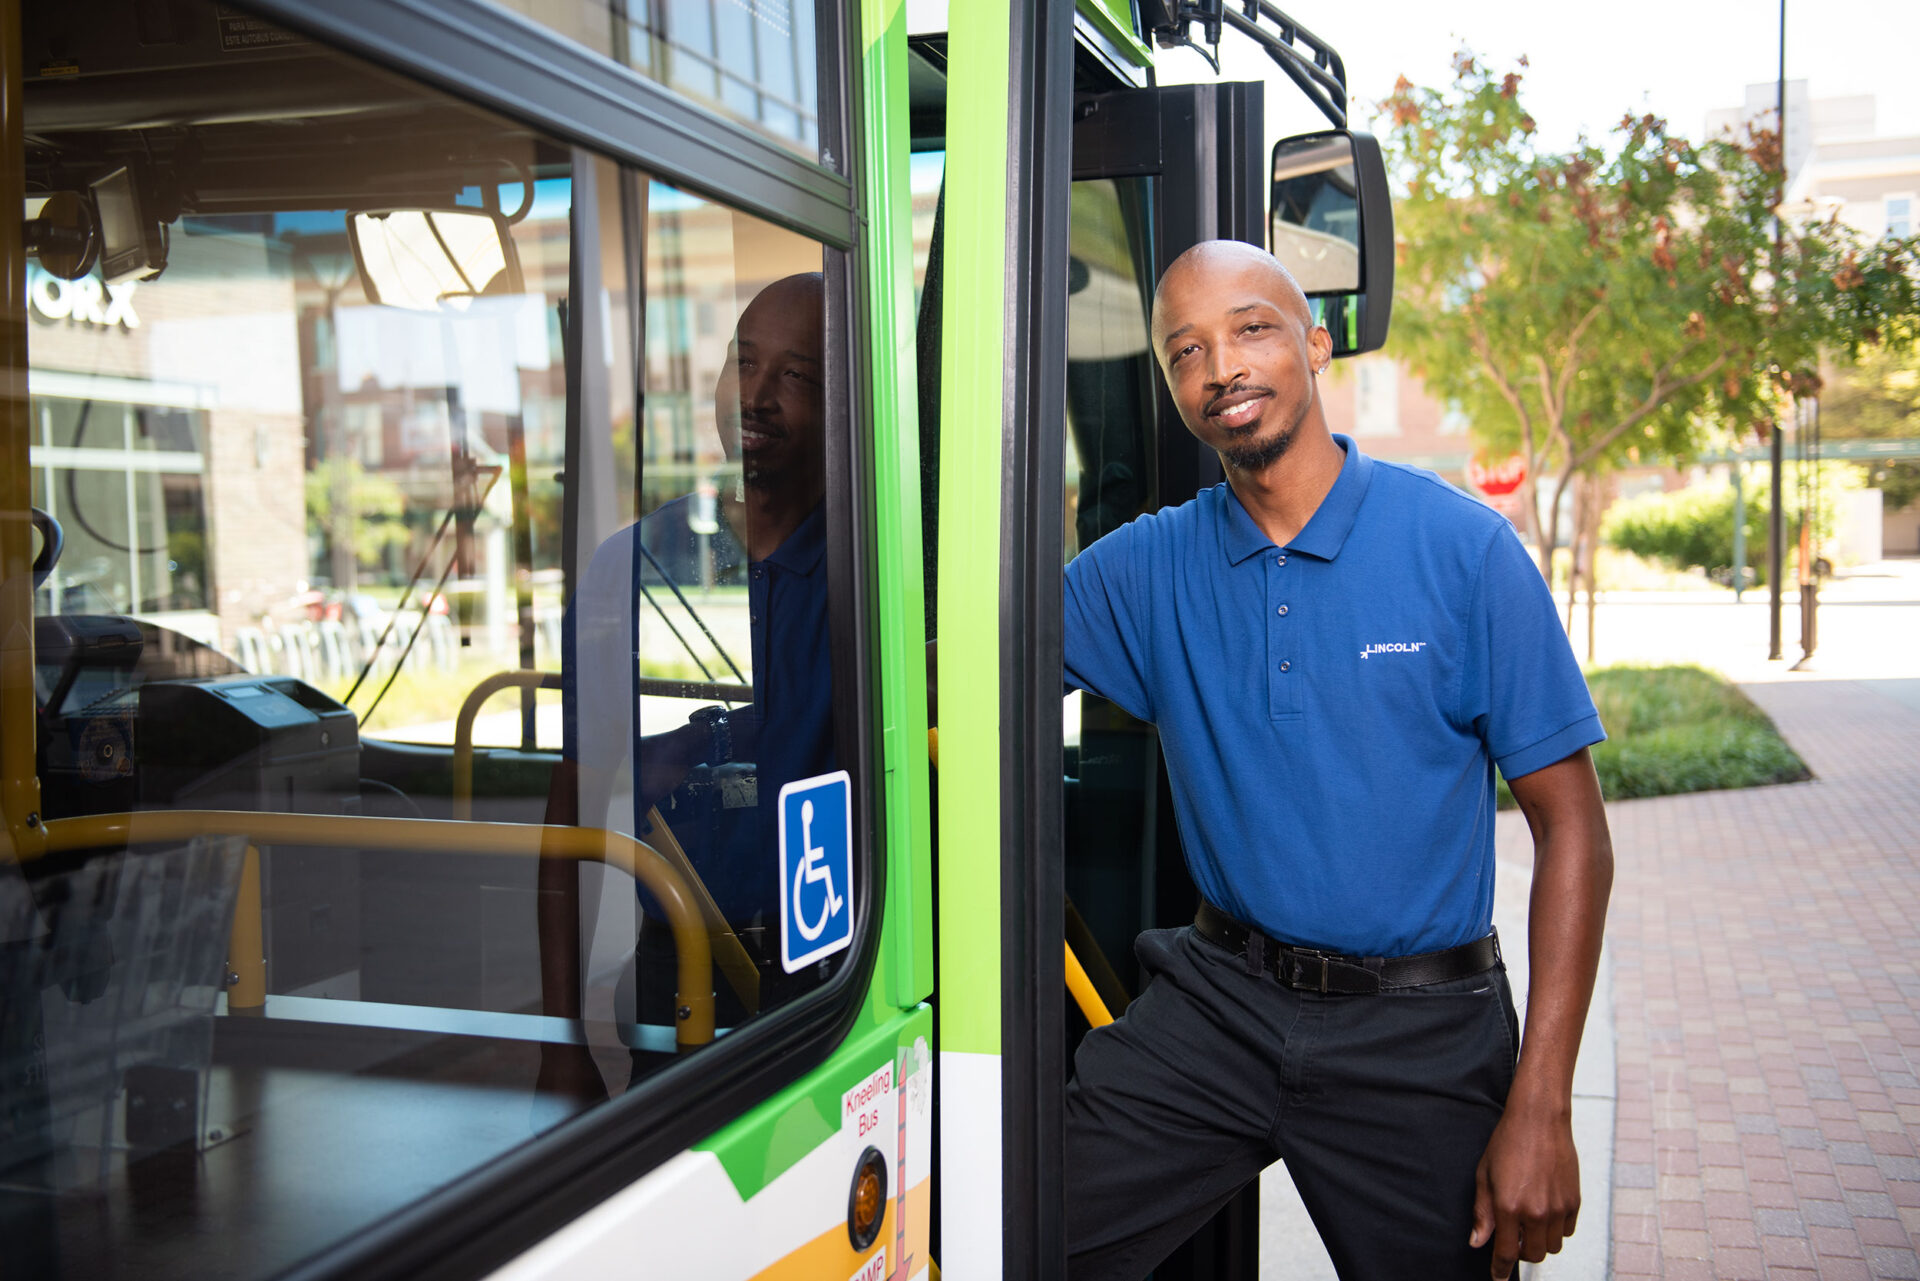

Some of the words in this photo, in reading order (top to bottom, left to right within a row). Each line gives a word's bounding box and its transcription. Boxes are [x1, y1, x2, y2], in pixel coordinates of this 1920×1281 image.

[26, 263, 141, 329] ORX
[1366, 642, 1420, 654] LINCOLN
[846, 1070, 890, 1117] Kneeling
[859, 1109, 879, 1137] Bus
